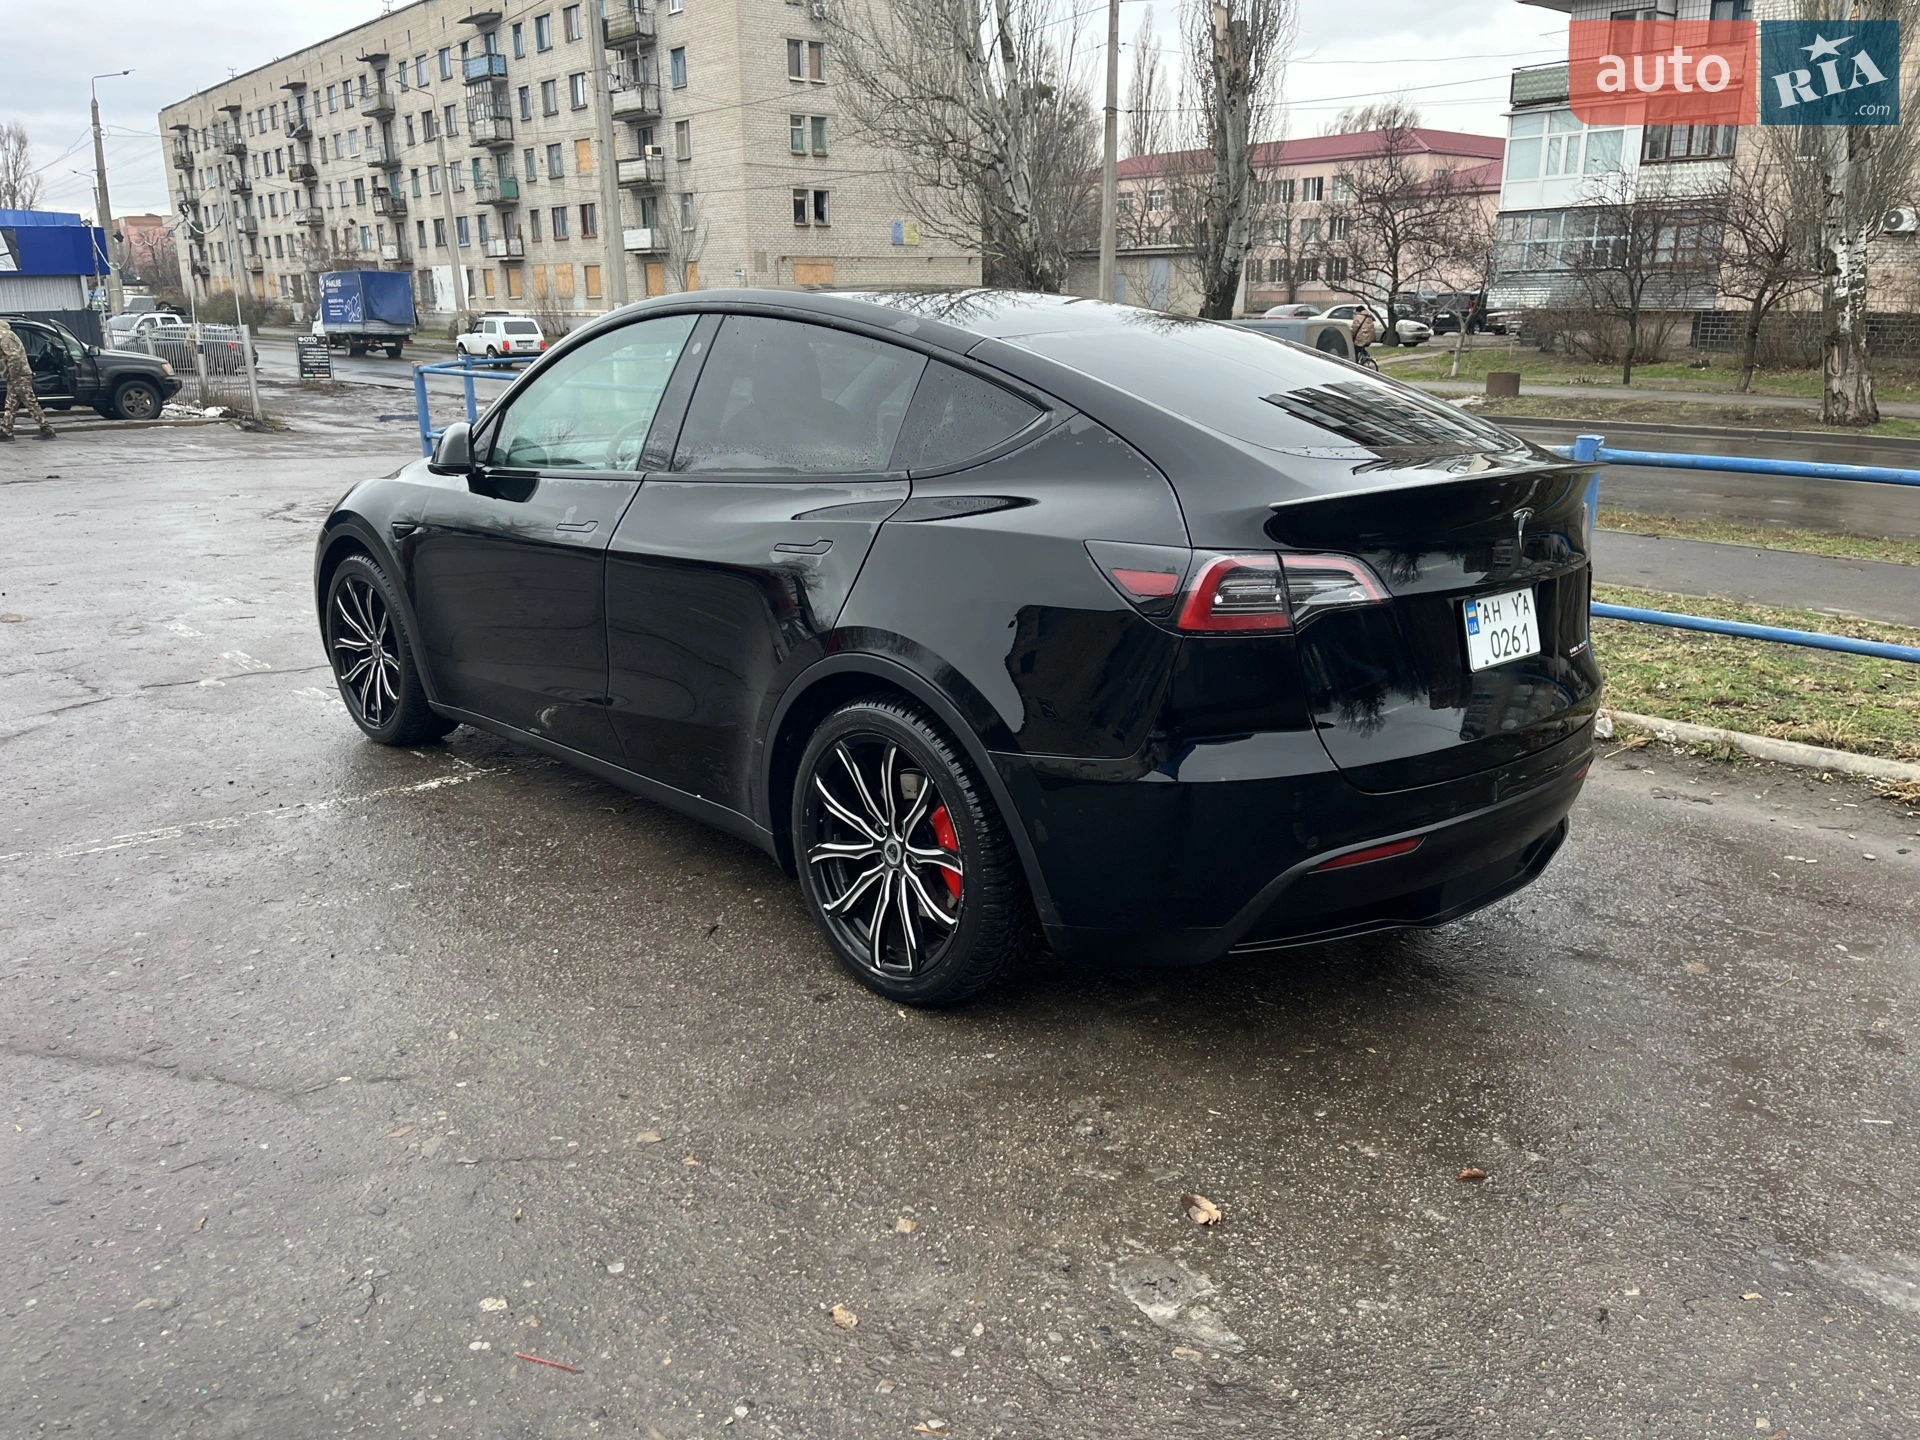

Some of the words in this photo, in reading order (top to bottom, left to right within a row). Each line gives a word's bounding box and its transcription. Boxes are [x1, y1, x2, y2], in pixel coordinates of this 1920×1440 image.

[1483, 600, 1502, 624] AH
[1511, 594, 1531, 616] YA
[1469, 621, 1479, 634] UA
[1490, 622, 1531, 659] 0261
